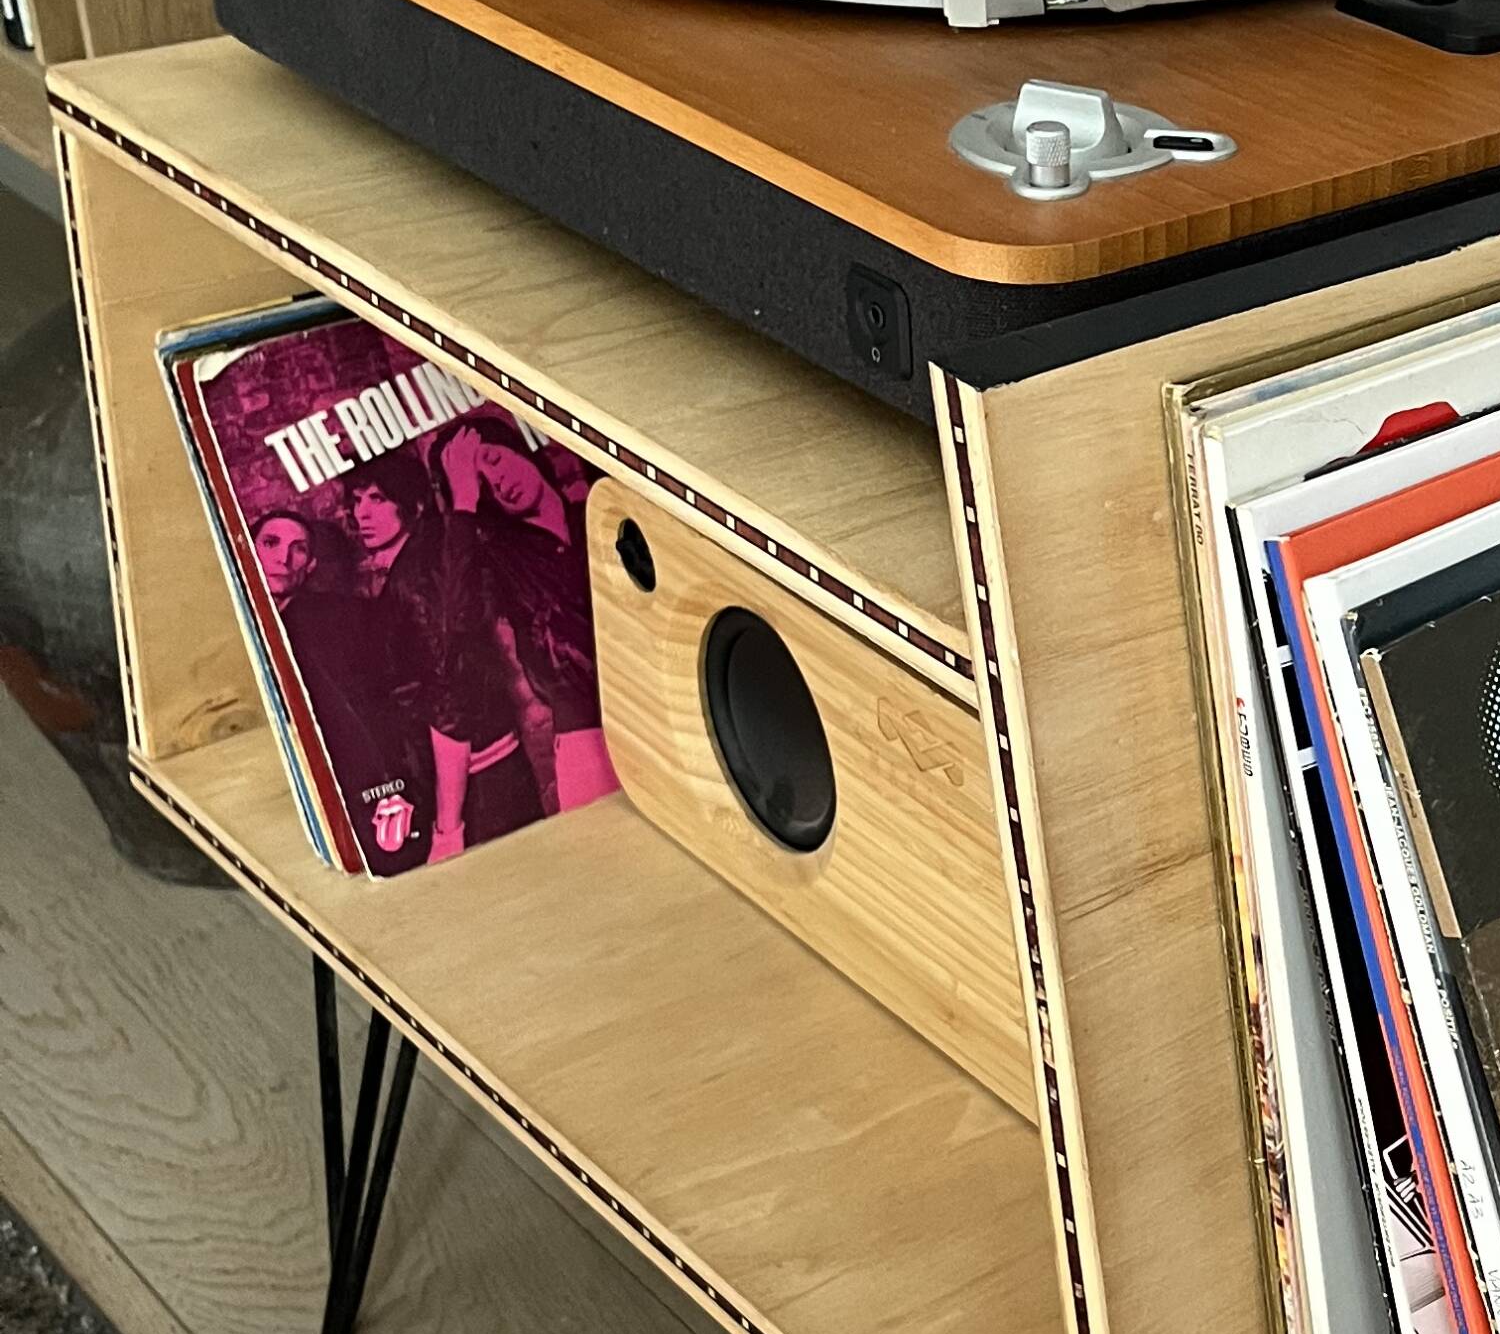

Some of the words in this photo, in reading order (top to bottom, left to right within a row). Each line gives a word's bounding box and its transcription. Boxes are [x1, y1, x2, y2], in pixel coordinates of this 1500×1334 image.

[264, 410, 355, 494] THE
[361, 778, 405, 804] STEREO
[1408, 882, 1435, 955] GOLDMAN
